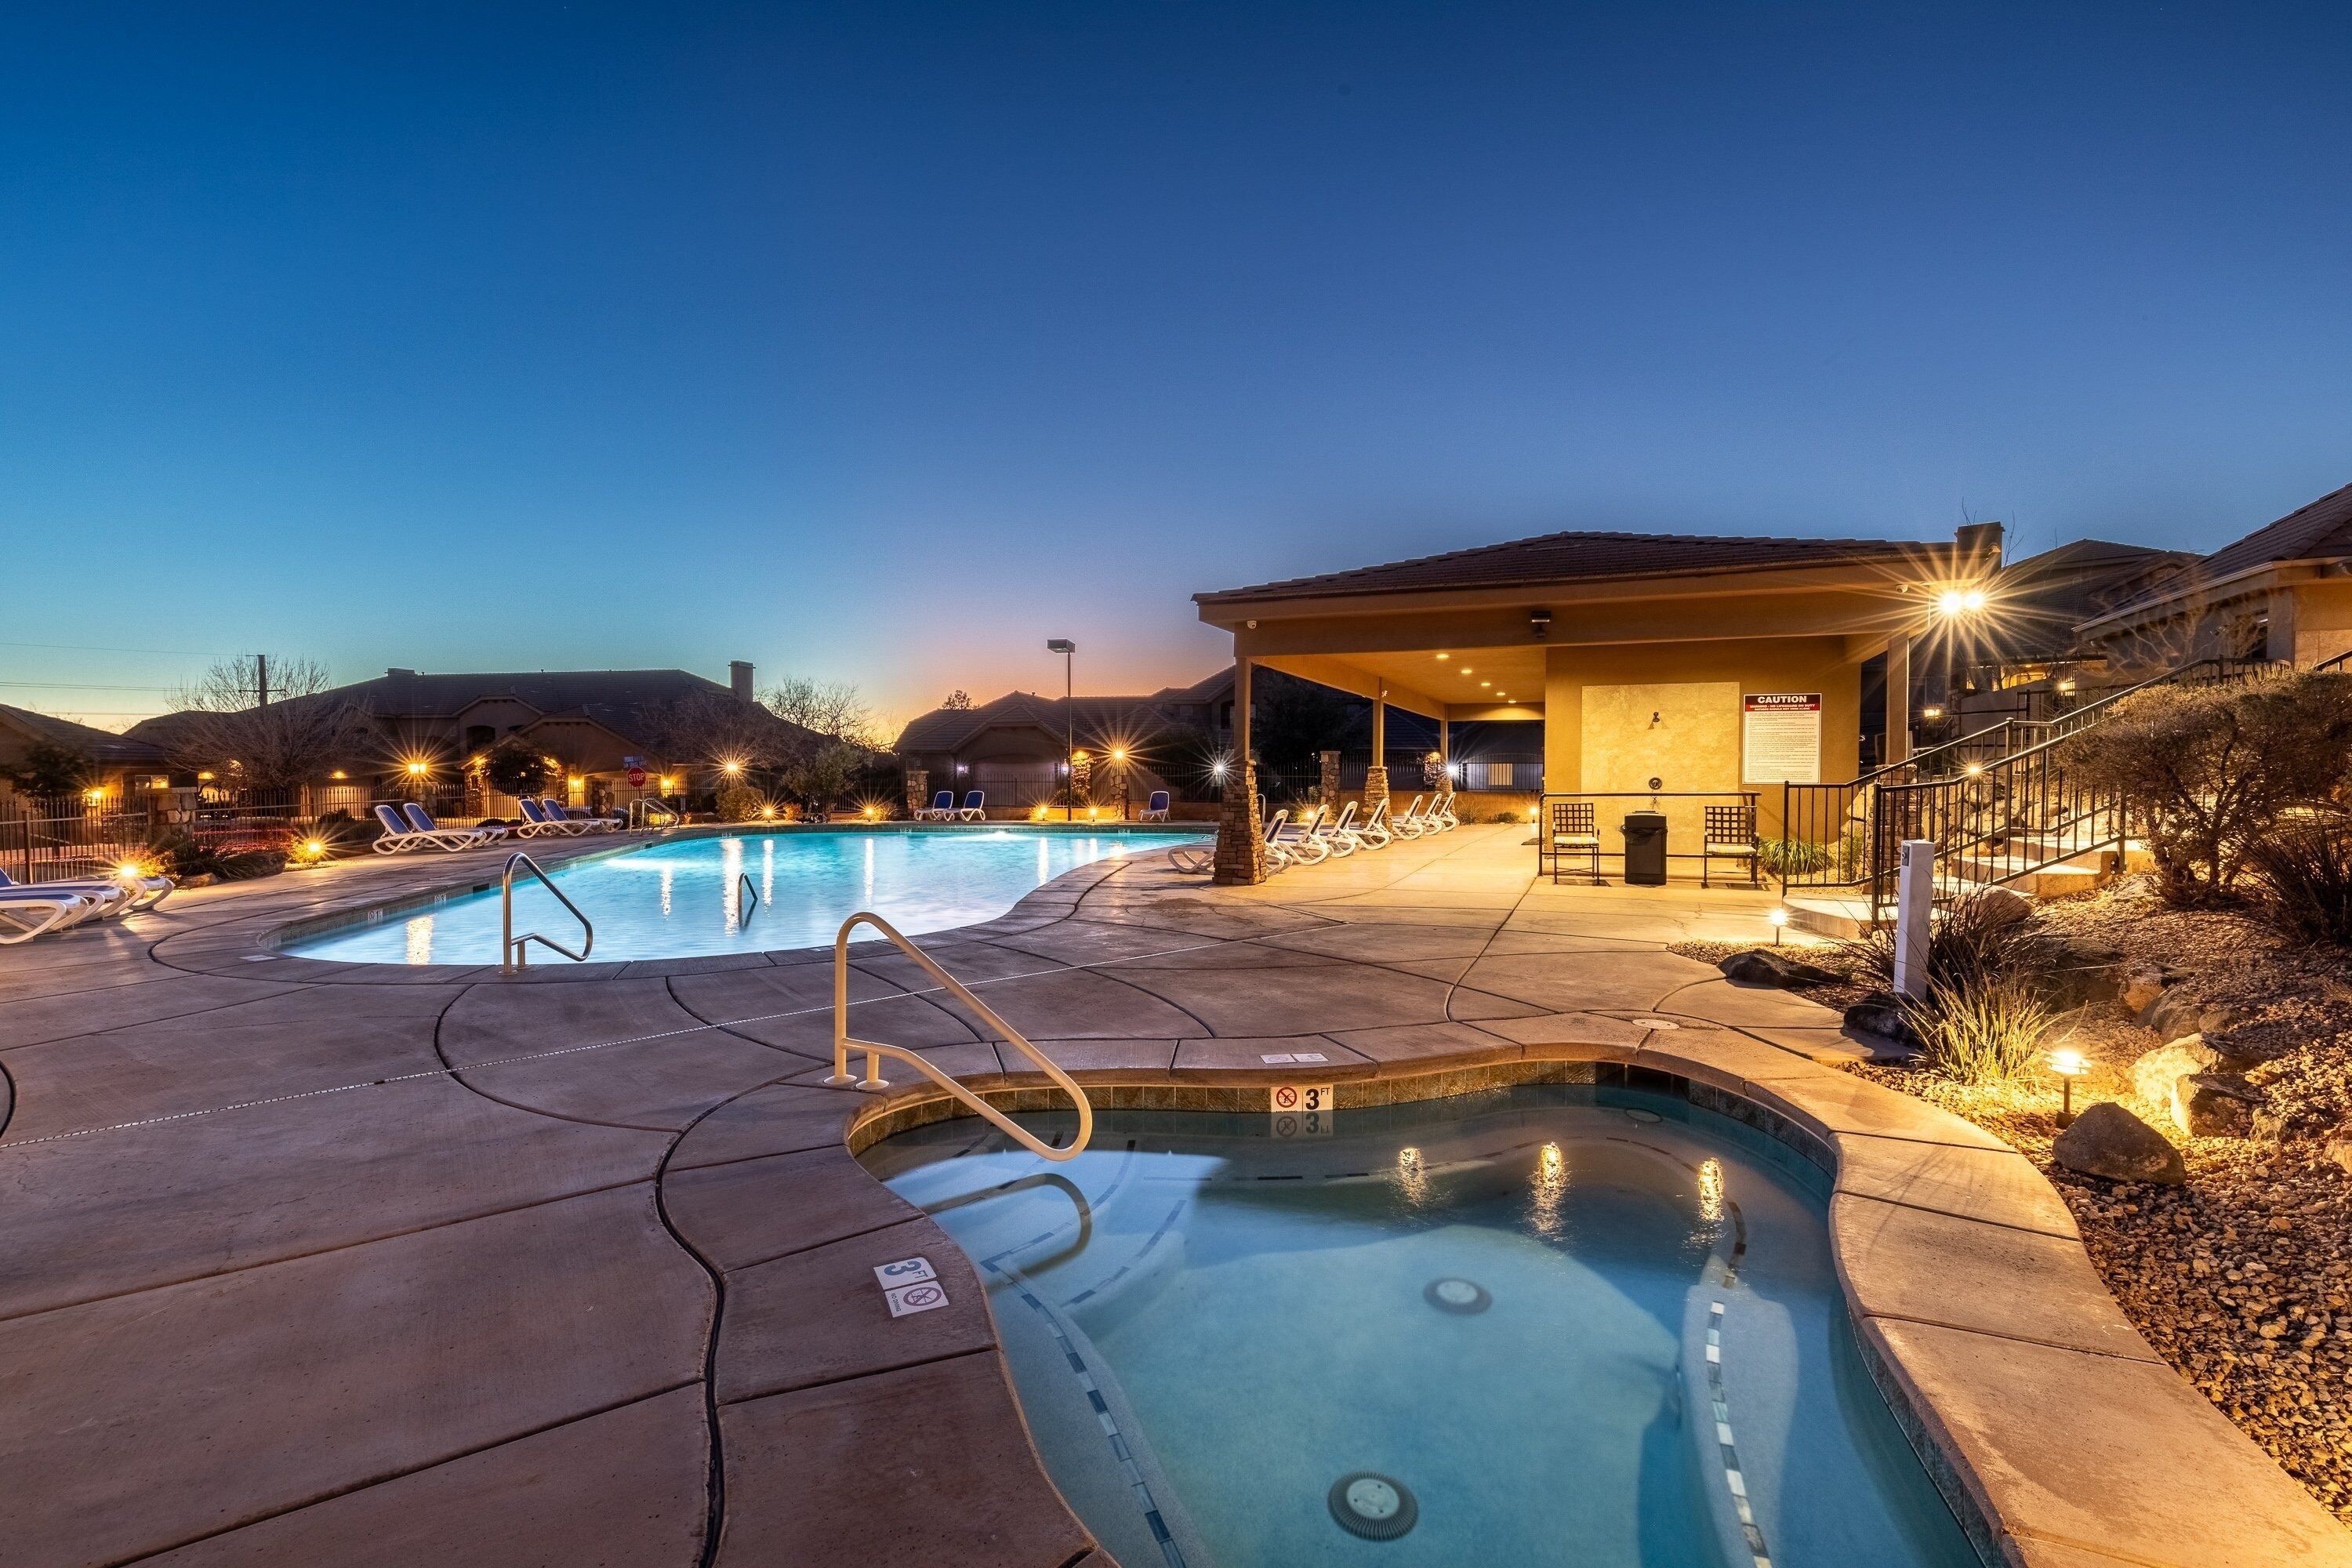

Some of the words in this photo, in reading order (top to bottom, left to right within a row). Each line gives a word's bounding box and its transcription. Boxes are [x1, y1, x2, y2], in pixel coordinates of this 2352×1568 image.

[629, 773, 645, 782] STOP
[1305, 1088, 1319, 1109] 3
[884, 1261, 922, 1276] 3
[912, 1270, 929, 1279] FT
[893, 1298, 902, 1312] DIVING
